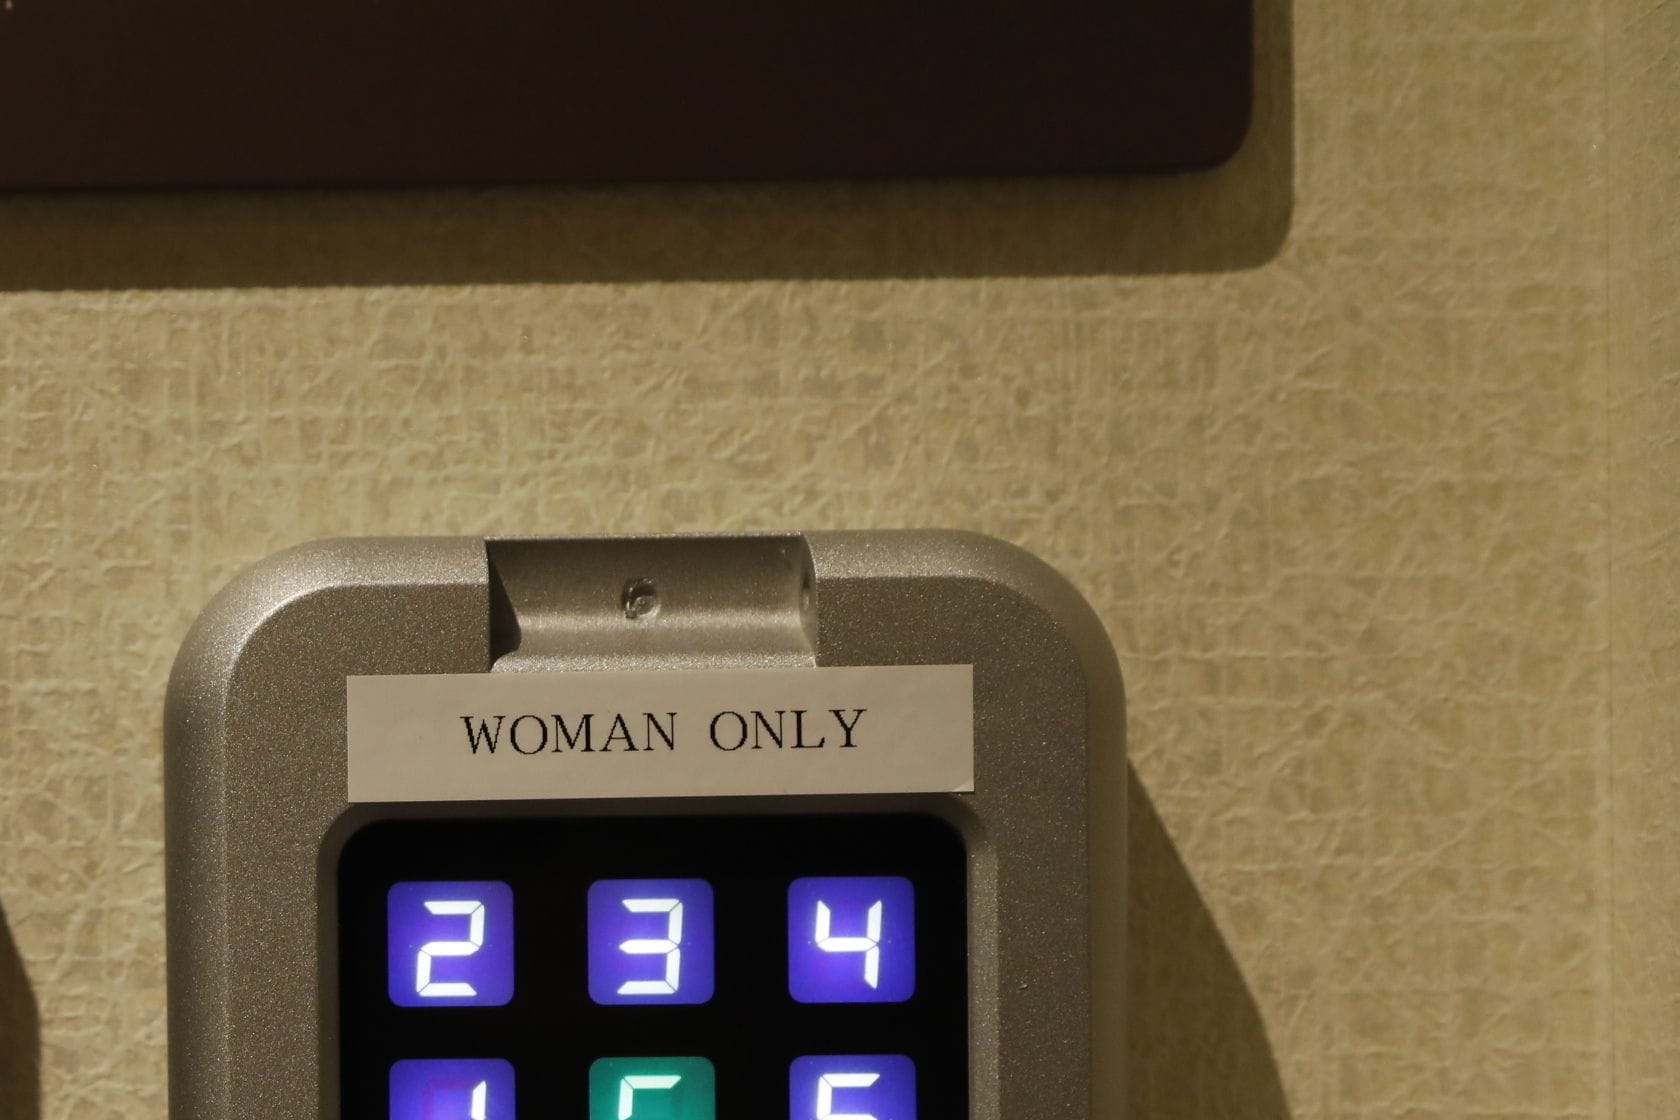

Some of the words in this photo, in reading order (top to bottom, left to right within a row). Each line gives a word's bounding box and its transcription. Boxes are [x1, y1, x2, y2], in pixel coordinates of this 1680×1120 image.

[461, 711, 678, 755] WOMAN
[709, 708, 868, 751] ONLY
[416, 901, 484, 996] 2
[618, 899, 682, 994] 3
[815, 901, 881, 988] 4
